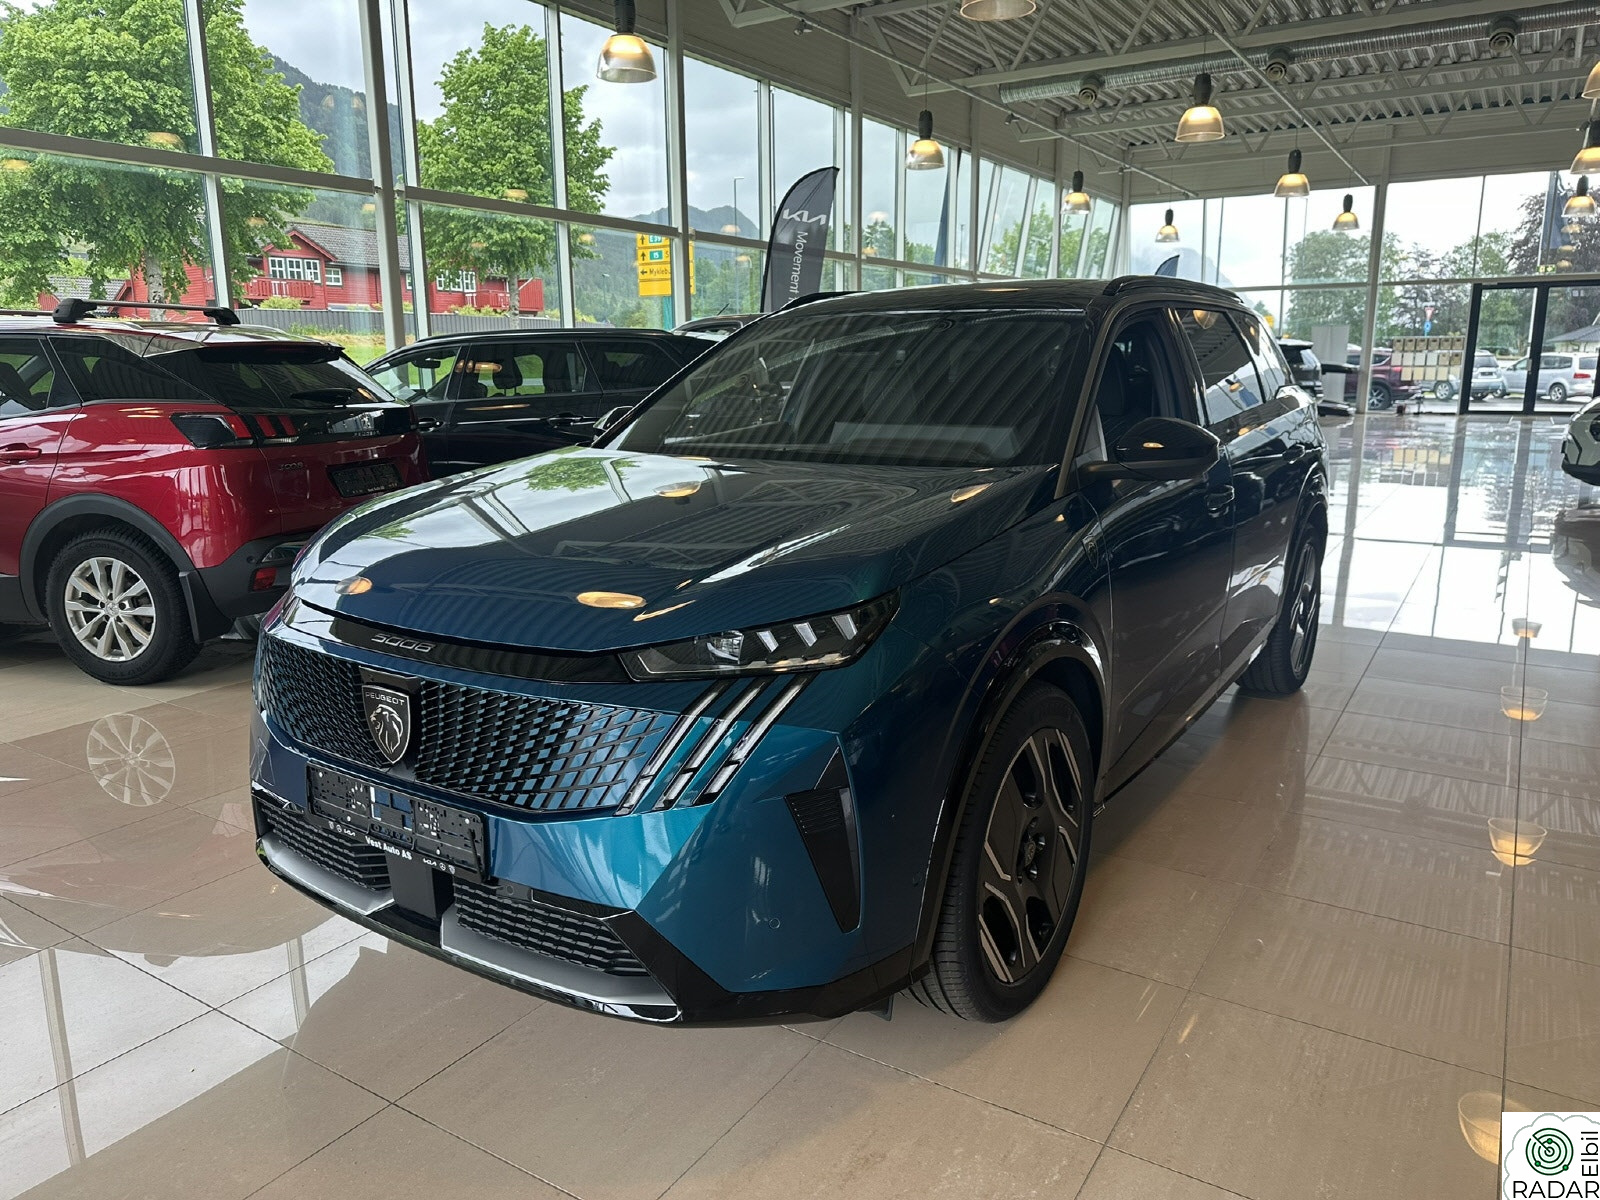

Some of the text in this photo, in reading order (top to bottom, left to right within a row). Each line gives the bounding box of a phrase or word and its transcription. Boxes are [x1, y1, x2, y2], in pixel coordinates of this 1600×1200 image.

[789, 231, 809, 294] Movement
[365, 691, 405, 706] PEUGEOT
[364, 836, 382, 850] Vest
[383, 842, 401, 856] Auto
[401, 849, 413, 861] AS
